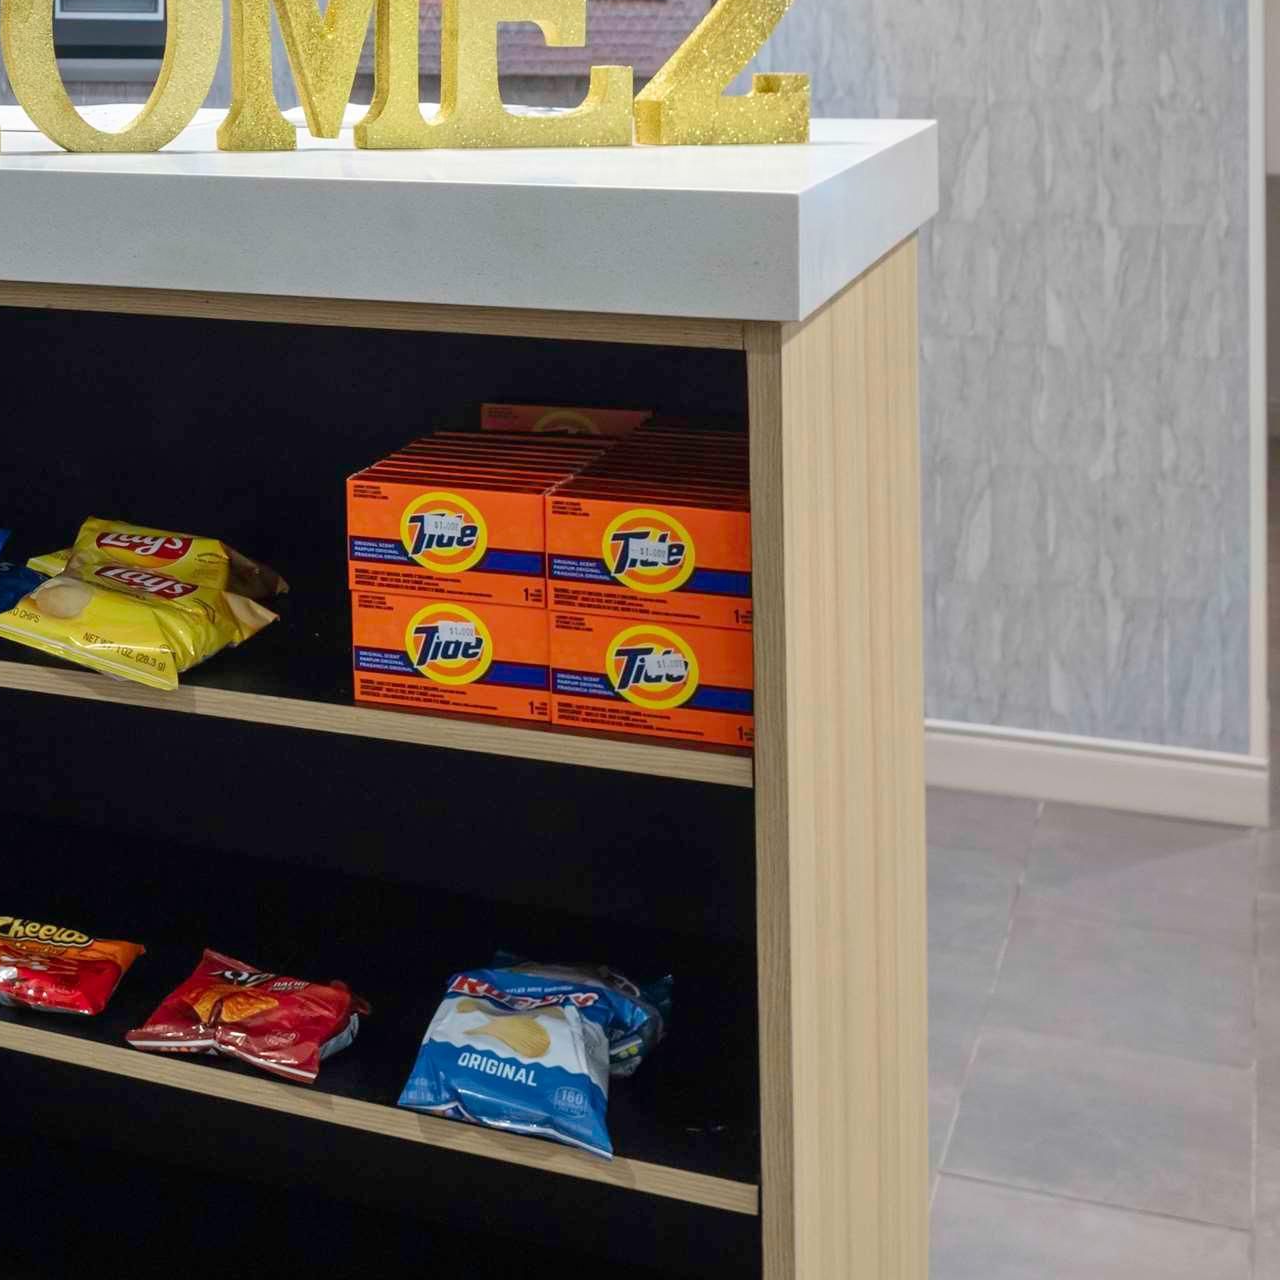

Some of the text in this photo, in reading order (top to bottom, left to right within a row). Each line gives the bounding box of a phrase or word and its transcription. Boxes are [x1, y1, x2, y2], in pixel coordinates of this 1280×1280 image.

[522, 586, 529, 602] 1
[733, 608, 740, 624] 1
[83, 631, 99, 643] NET
[528, 700, 535, 715] 1
[457, 1051, 538, 1087] ORIGINAL
